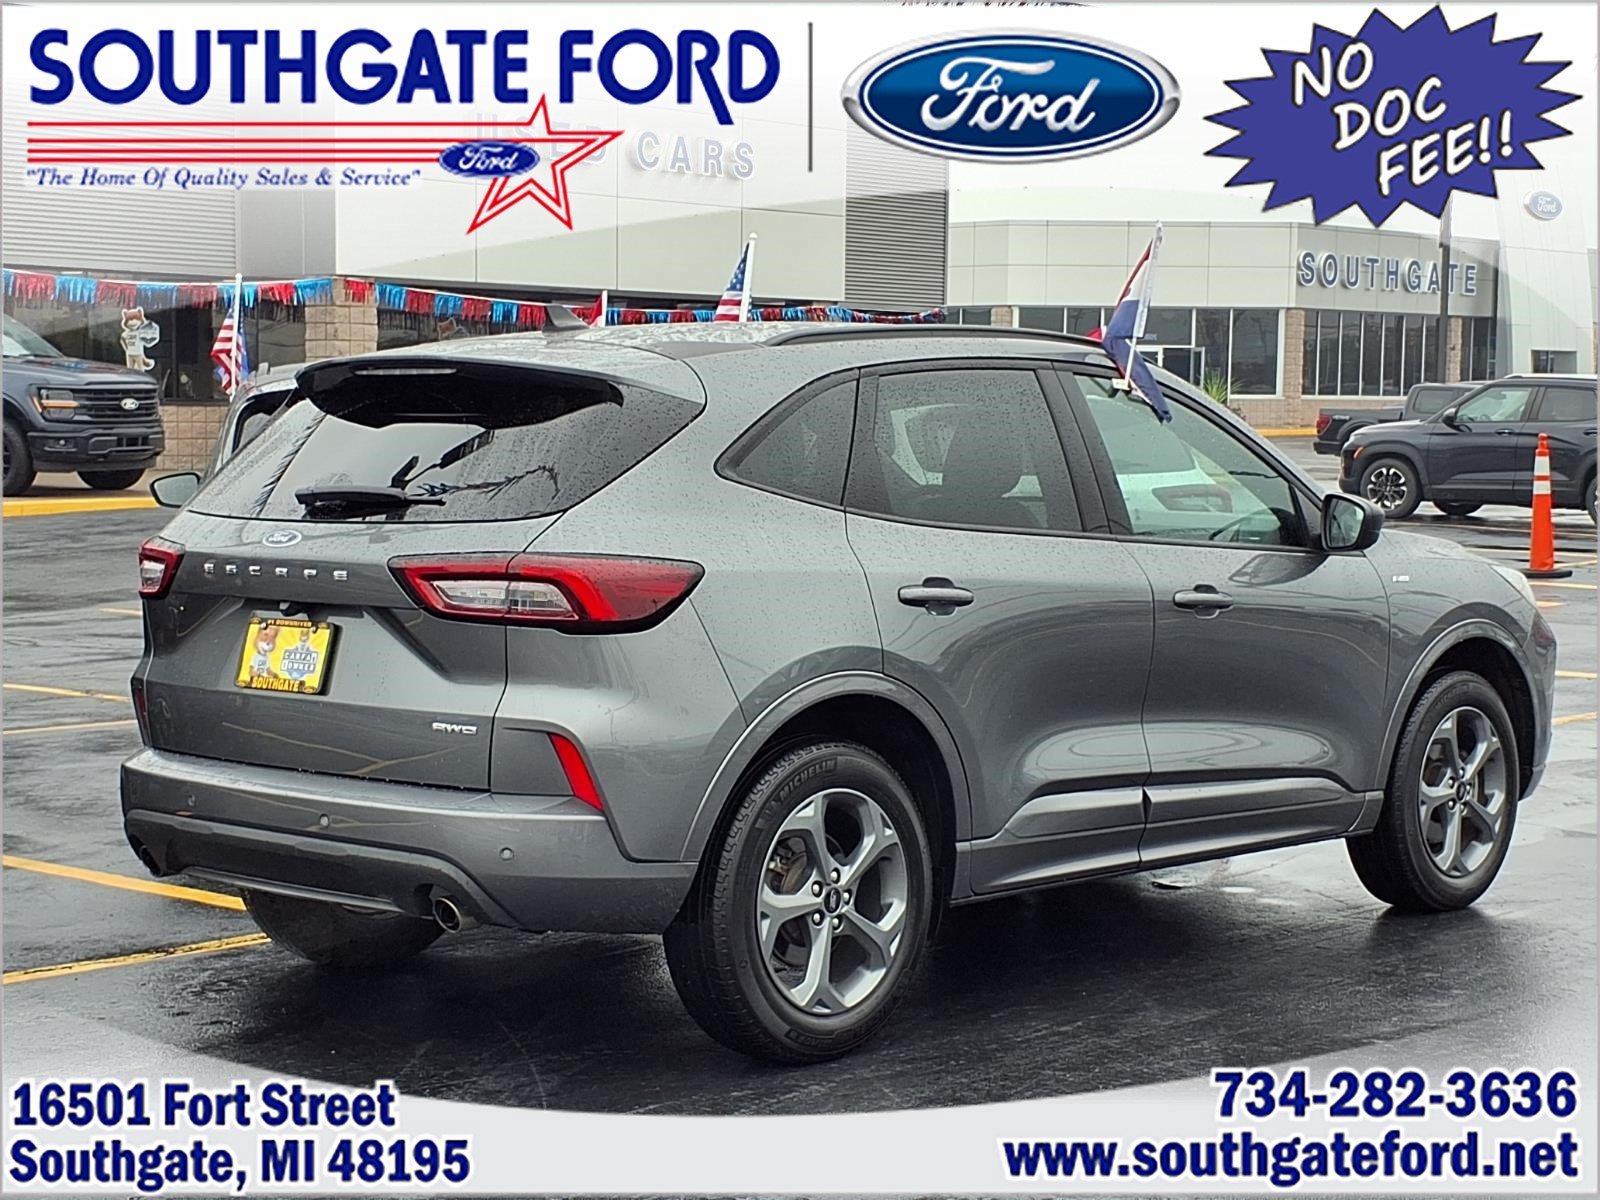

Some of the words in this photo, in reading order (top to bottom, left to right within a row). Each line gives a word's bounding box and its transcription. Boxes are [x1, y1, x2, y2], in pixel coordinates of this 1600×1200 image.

[633, 130, 756, 180] CARS
[1298, 251, 1479, 296] SOUTHGATE
[252, 676, 299, 691] SOUTHGATE
[780, 760, 836, 800] MICHELIN
